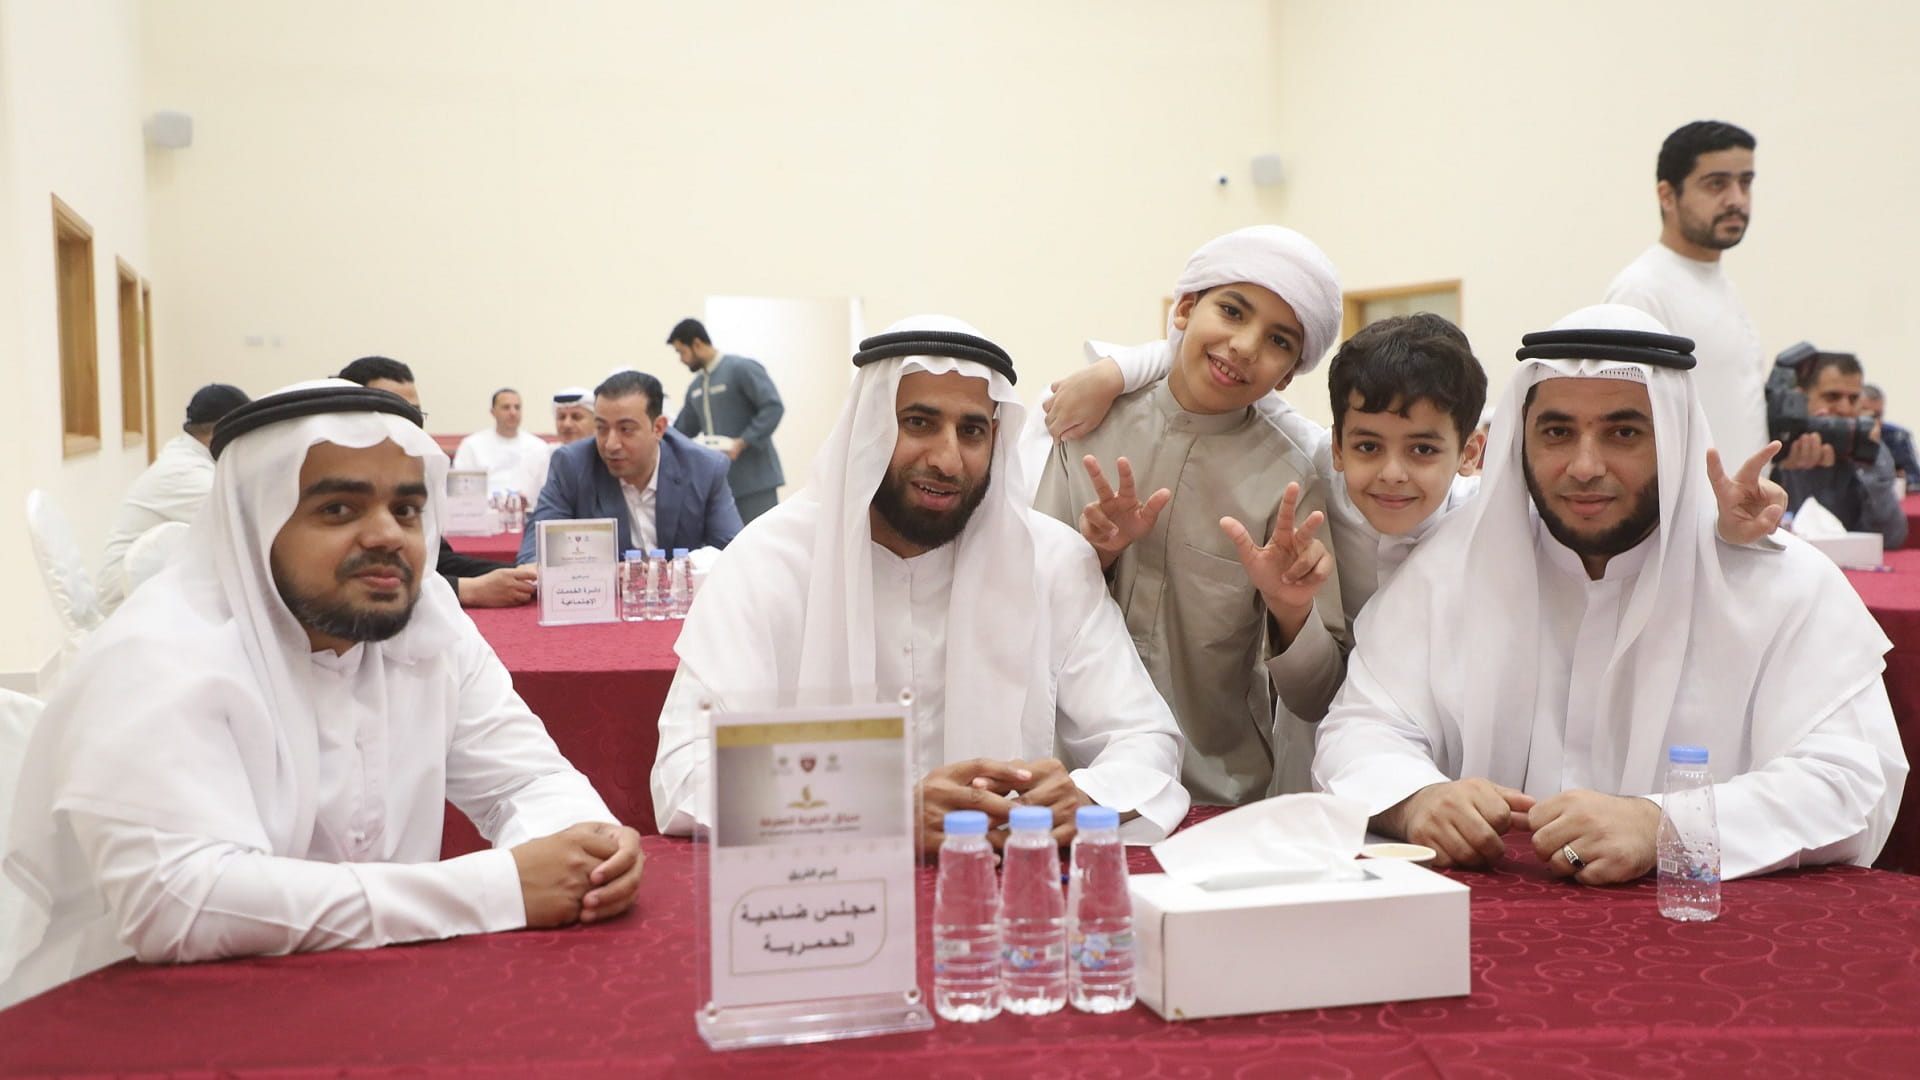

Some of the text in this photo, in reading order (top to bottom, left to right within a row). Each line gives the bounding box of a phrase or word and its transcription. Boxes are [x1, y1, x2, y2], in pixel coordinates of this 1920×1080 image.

[741, 900, 876, 926] مجلس ضاحية
[763, 931, 855, 956] الحمرية
